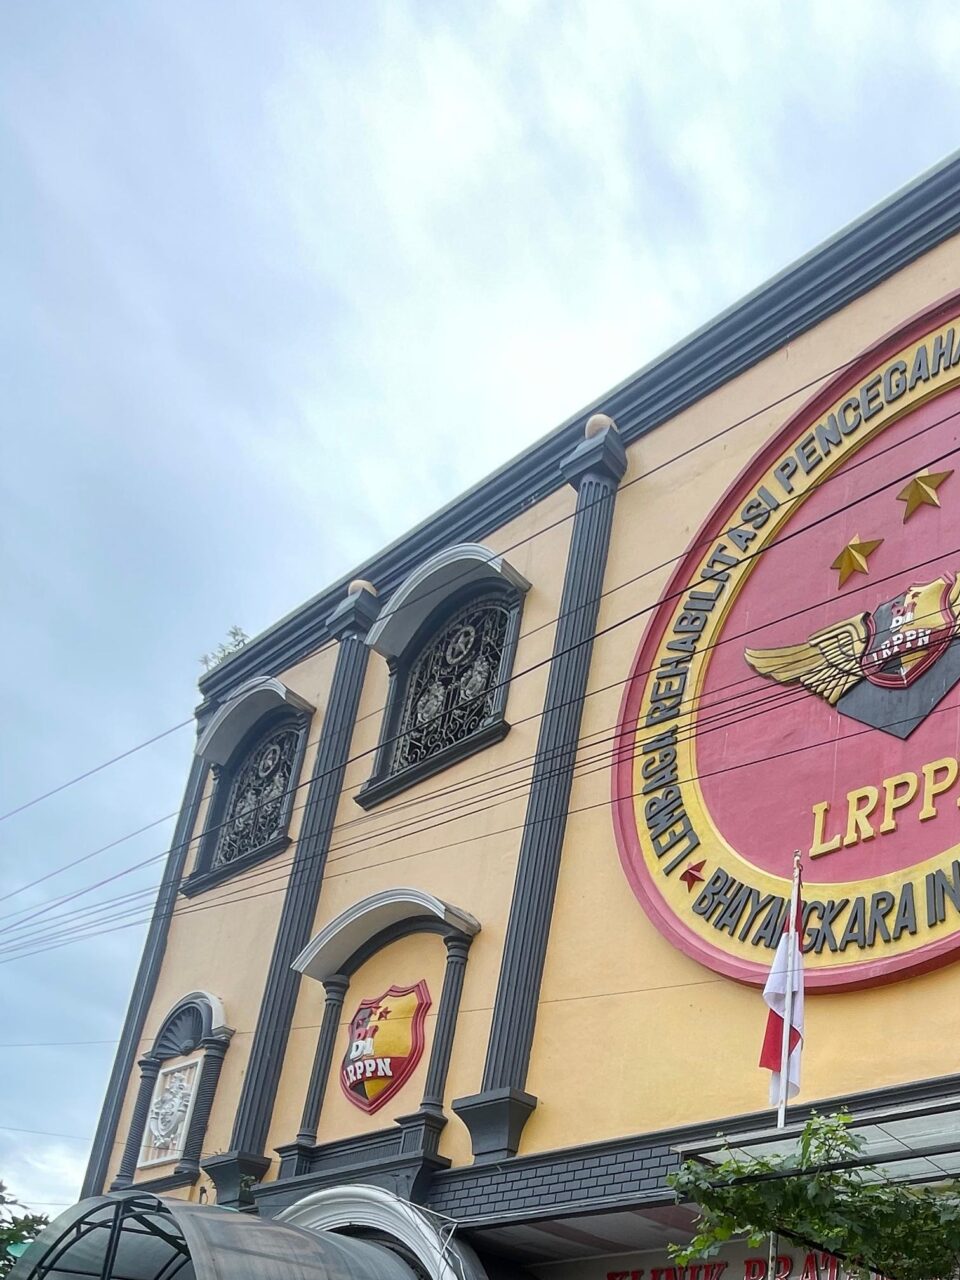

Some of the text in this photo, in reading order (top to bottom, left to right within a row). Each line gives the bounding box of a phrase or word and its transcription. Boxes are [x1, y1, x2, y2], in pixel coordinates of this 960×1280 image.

[646, 484, 781, 729] REHABILITASI
[642, 724, 701, 877] LEMBAGA
[343, 1057, 393, 1086] LRPPN
